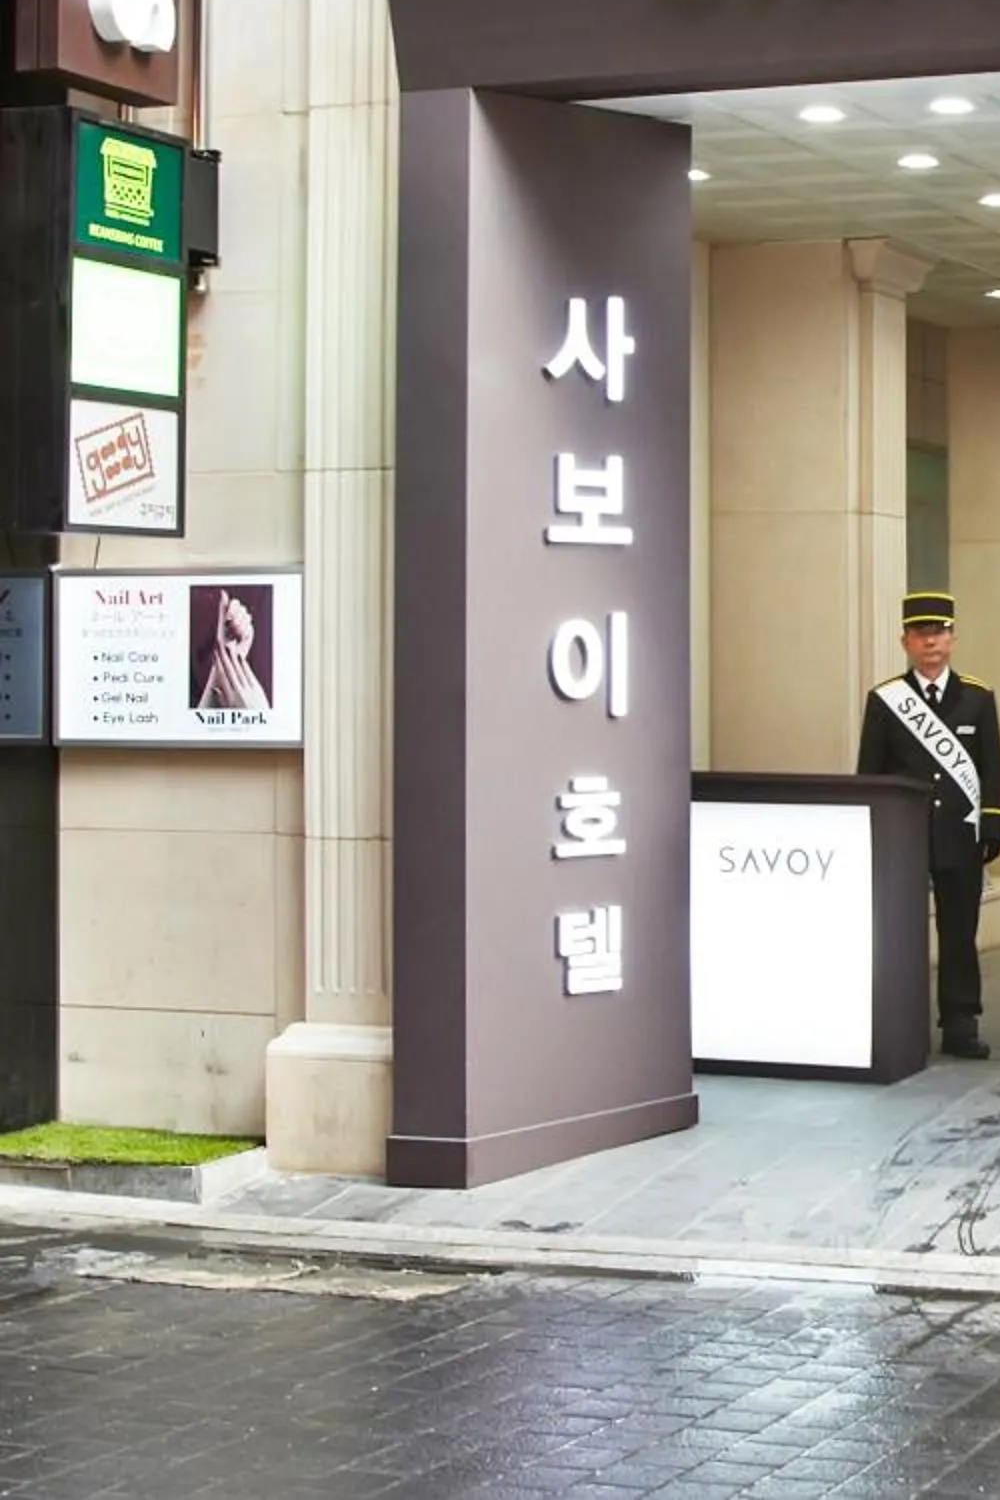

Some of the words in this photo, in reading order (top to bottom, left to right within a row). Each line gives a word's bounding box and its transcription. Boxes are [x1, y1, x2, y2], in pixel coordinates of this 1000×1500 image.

[95, 589, 129, 605] Nail
[139, 589, 163, 605] Art
[101, 652, 124, 663] Nail
[128, 652, 159, 663] Care
[103, 672, 128, 683] Pedi
[134, 672, 164, 683] Cure
[101, 692, 122, 703] Gel
[126, 692, 149, 703] Nail
[103, 712, 125, 725] Eye
[130, 712, 159, 724] Lash
[195, 711, 225, 725] Nail
[231, 711, 267, 725] Park
[897, 697, 967, 769] SAVOY
[719, 845, 835, 881] SAVOY
